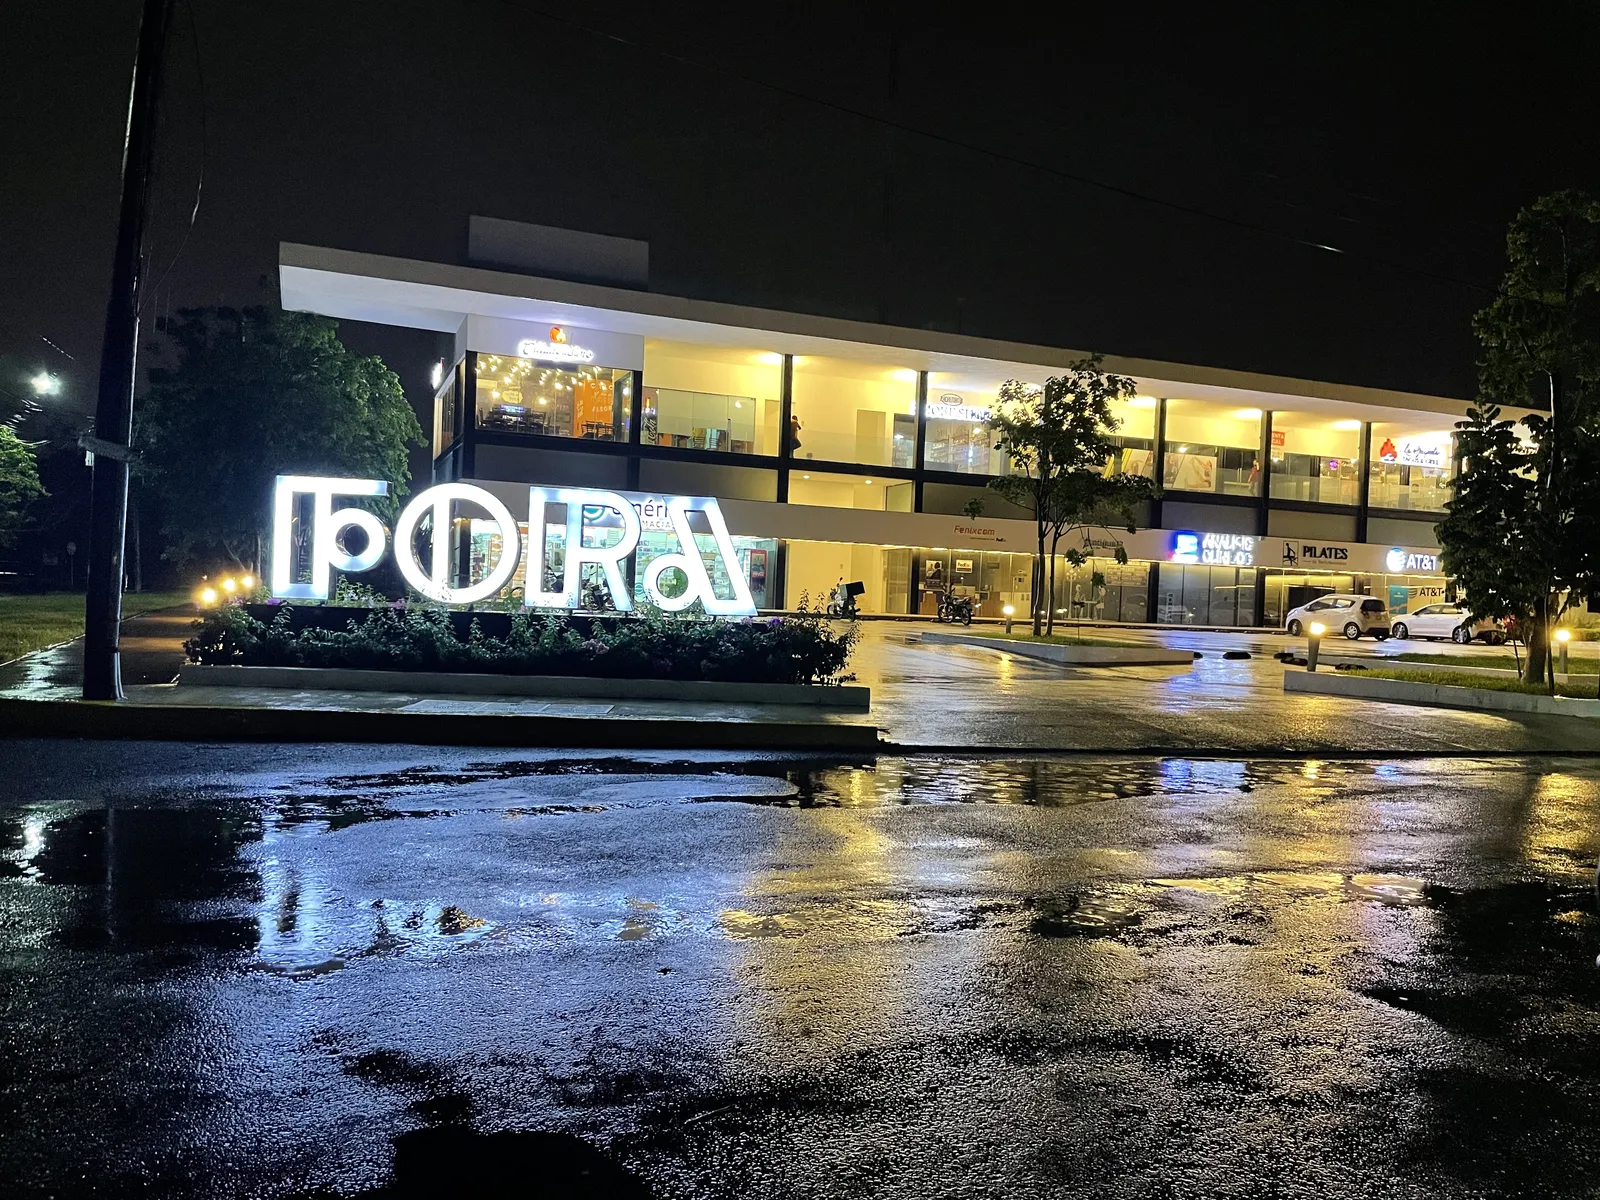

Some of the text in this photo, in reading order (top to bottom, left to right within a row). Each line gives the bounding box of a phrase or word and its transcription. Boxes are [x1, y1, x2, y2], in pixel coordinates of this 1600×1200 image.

[954, 525, 995, 536] Fenixcom
[1303, 545, 1348, 560] PILATES
[1406, 553, 1437, 571] AT&T
[1419, 587, 1442, 597] AT&T
